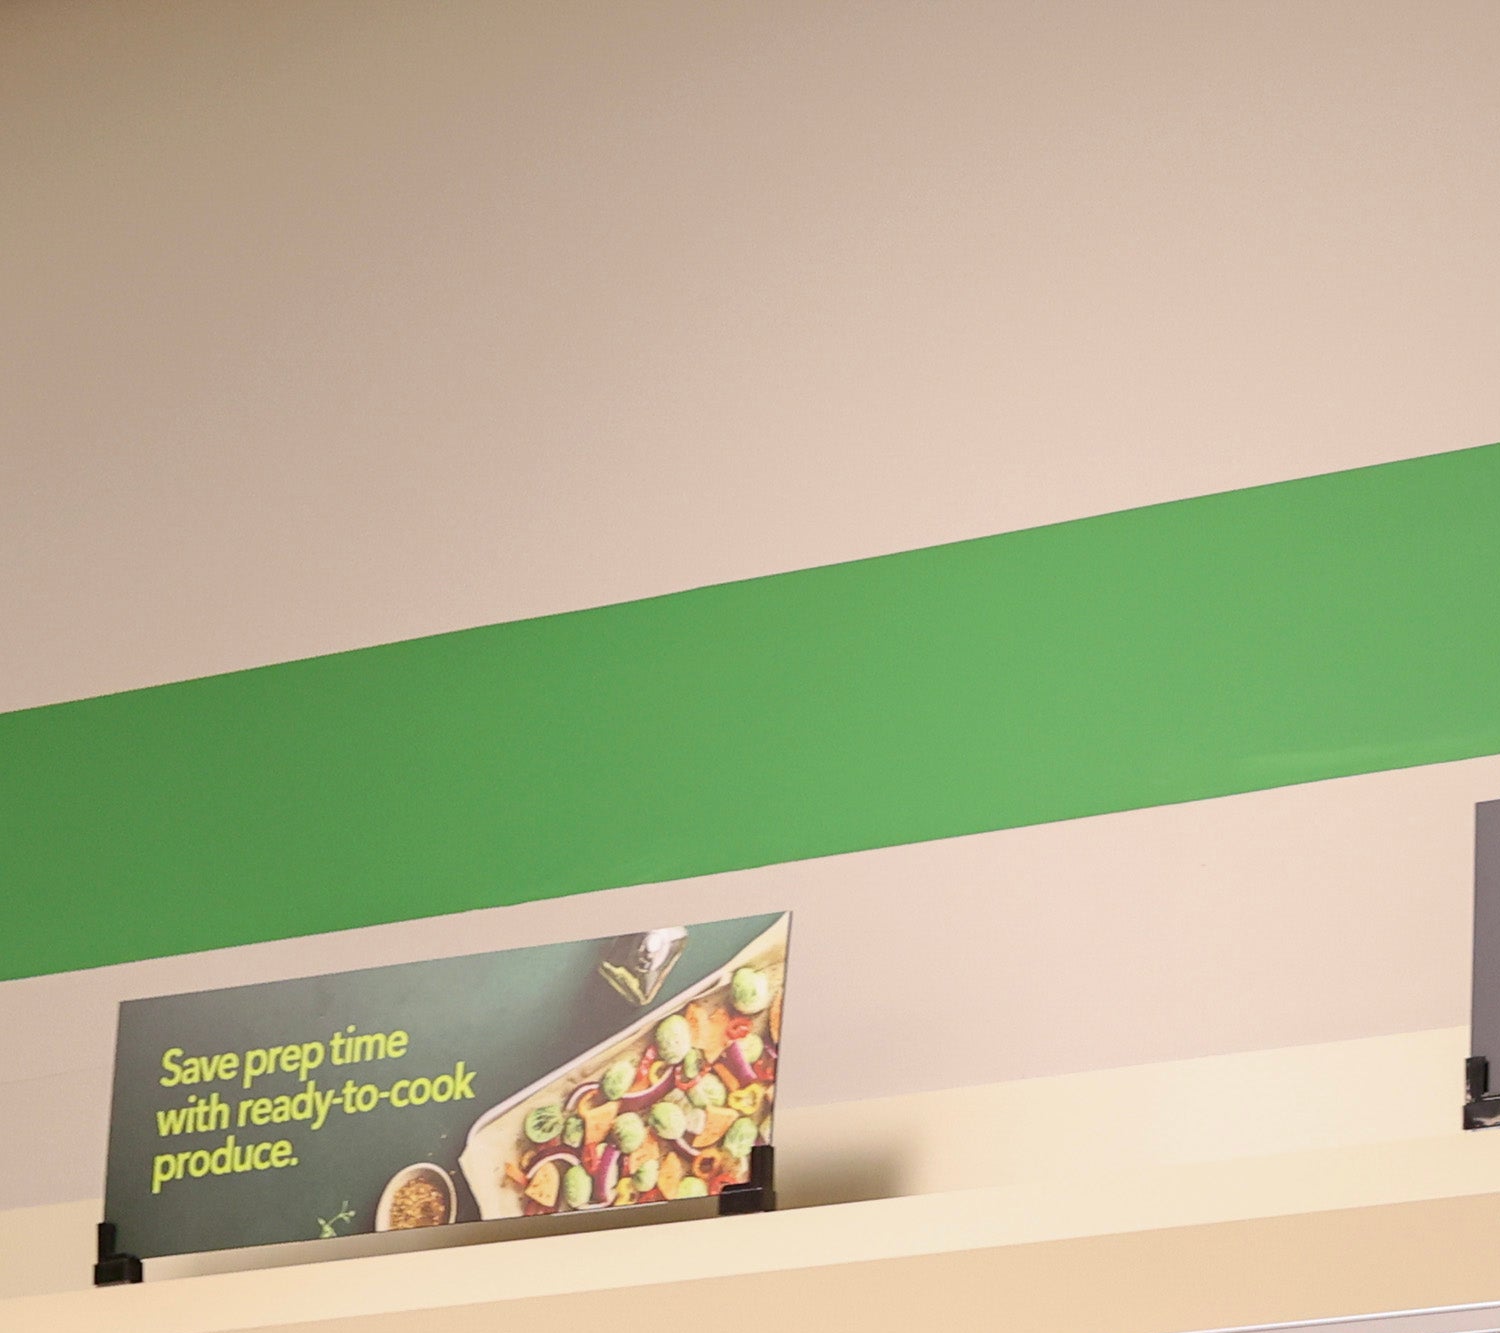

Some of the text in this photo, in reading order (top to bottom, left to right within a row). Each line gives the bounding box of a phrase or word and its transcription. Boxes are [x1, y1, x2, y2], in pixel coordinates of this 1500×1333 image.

[159, 1026, 409, 1089] Save prep time
[156, 1061, 476, 1137] with ready-to-cook
[152, 1136, 300, 1193] produce.
